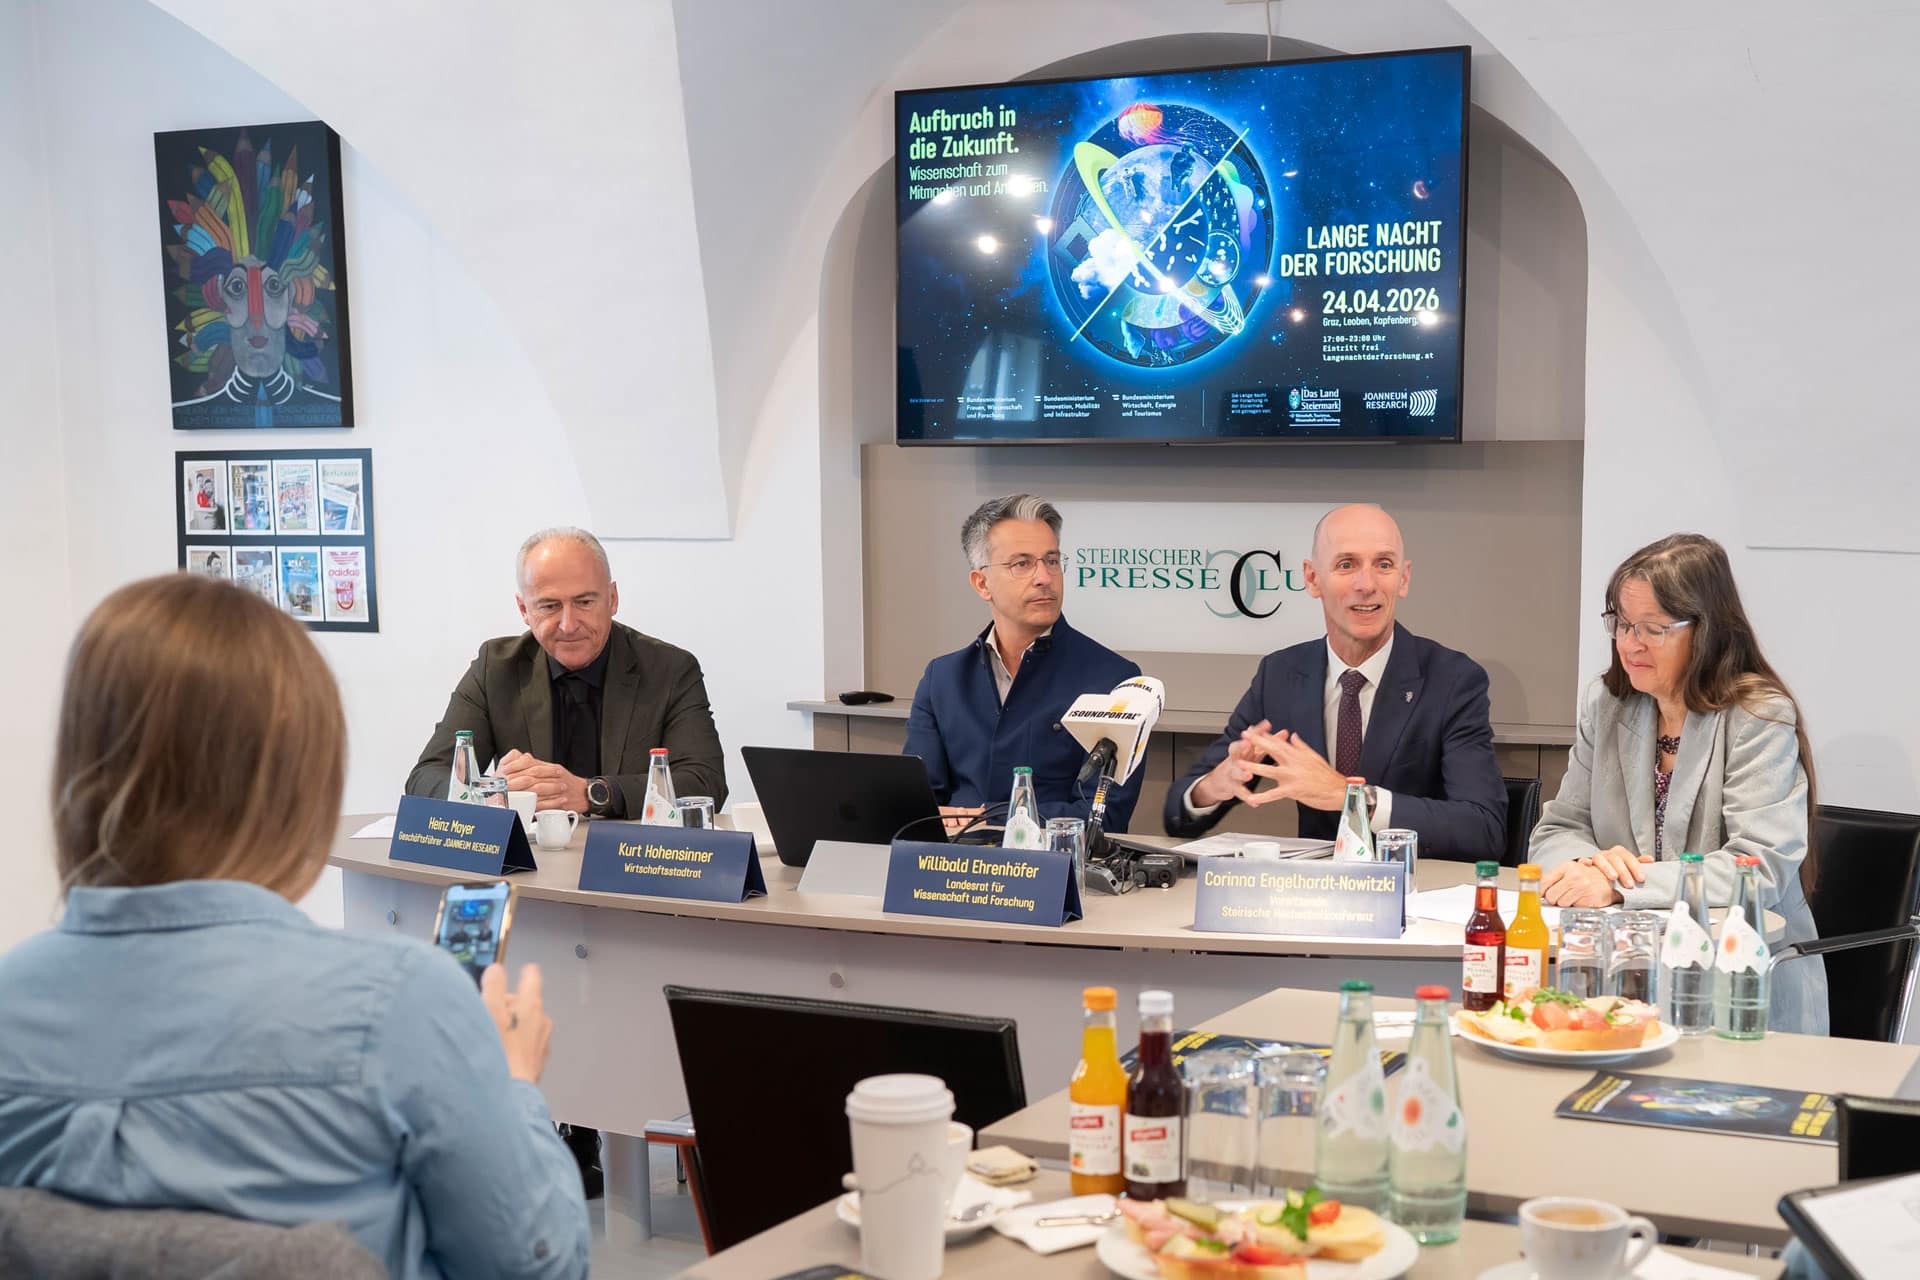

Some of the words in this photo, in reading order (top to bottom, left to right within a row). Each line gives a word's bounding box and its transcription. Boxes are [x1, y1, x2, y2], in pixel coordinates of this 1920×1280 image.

[909, 106, 993, 134] Aufbruch
[999, 104, 1016, 127] in
[909, 137, 937, 160] die
[941, 132, 1019, 158] Zukunft.
[909, 162, 982, 181] Wissenschaft
[986, 163, 1008, 177] zum
[969, 181, 990, 197] und
[1307, 224, 1369, 249] LANGE
[1376, 220, 1442, 247] NACHT
[1280, 253, 1317, 277] DER
[1325, 248, 1441, 276] FORSCHUNG
[1322, 288, 1440, 314] 24.04.2026
[1322, 317, 1341, 327] Graz,
[1343, 316, 1372, 327] Leoben,
[1372, 334, 1387, 342] Uhr
[1322, 344, 1358, 352] Eintritt
[1361, 343, 1379, 351] frei
[1322, 352, 1434, 363] langenachtderforschung.at
[1303, 389, 1318, 398] Das
[1320, 388, 1339, 398] Land
[1362, 392, 1408, 401] JOANNEUM
[1301, 401, 1339, 411] Steiermark
[1366, 400, 1408, 410] RESEARCH
[1076, 548, 1202, 566] STEIRISCHER
[1070, 710, 1138, 720] SOUNDPORTAL
[428, 816, 449, 832] Heinz
[450, 819, 476, 837] Mayer
[398, 831, 443, 847] Geschäftsführer
[443, 837, 471, 851] JOANNEUM
[471, 841, 501, 855] RESEARCH
[618, 842, 642, 858] Kurt
[644, 844, 714, 863] Hohensinner
[623, 862, 702, 879] Wirtschaftsstadtrat
[918, 855, 969, 873] Willibald
[972, 858, 1040, 879] Ehrenhöfer
[946, 878, 989, 892] Landesrat
[991, 881, 1005, 894] für
[1204, 871, 1256, 888] Corinna
[1260, 872, 1396, 893] Engelhardt-Nowitzki
[913, 888, 970, 905] Wissenschaft
[971, 893, 988, 905] und
[990, 895, 1035, 912] Forschung
